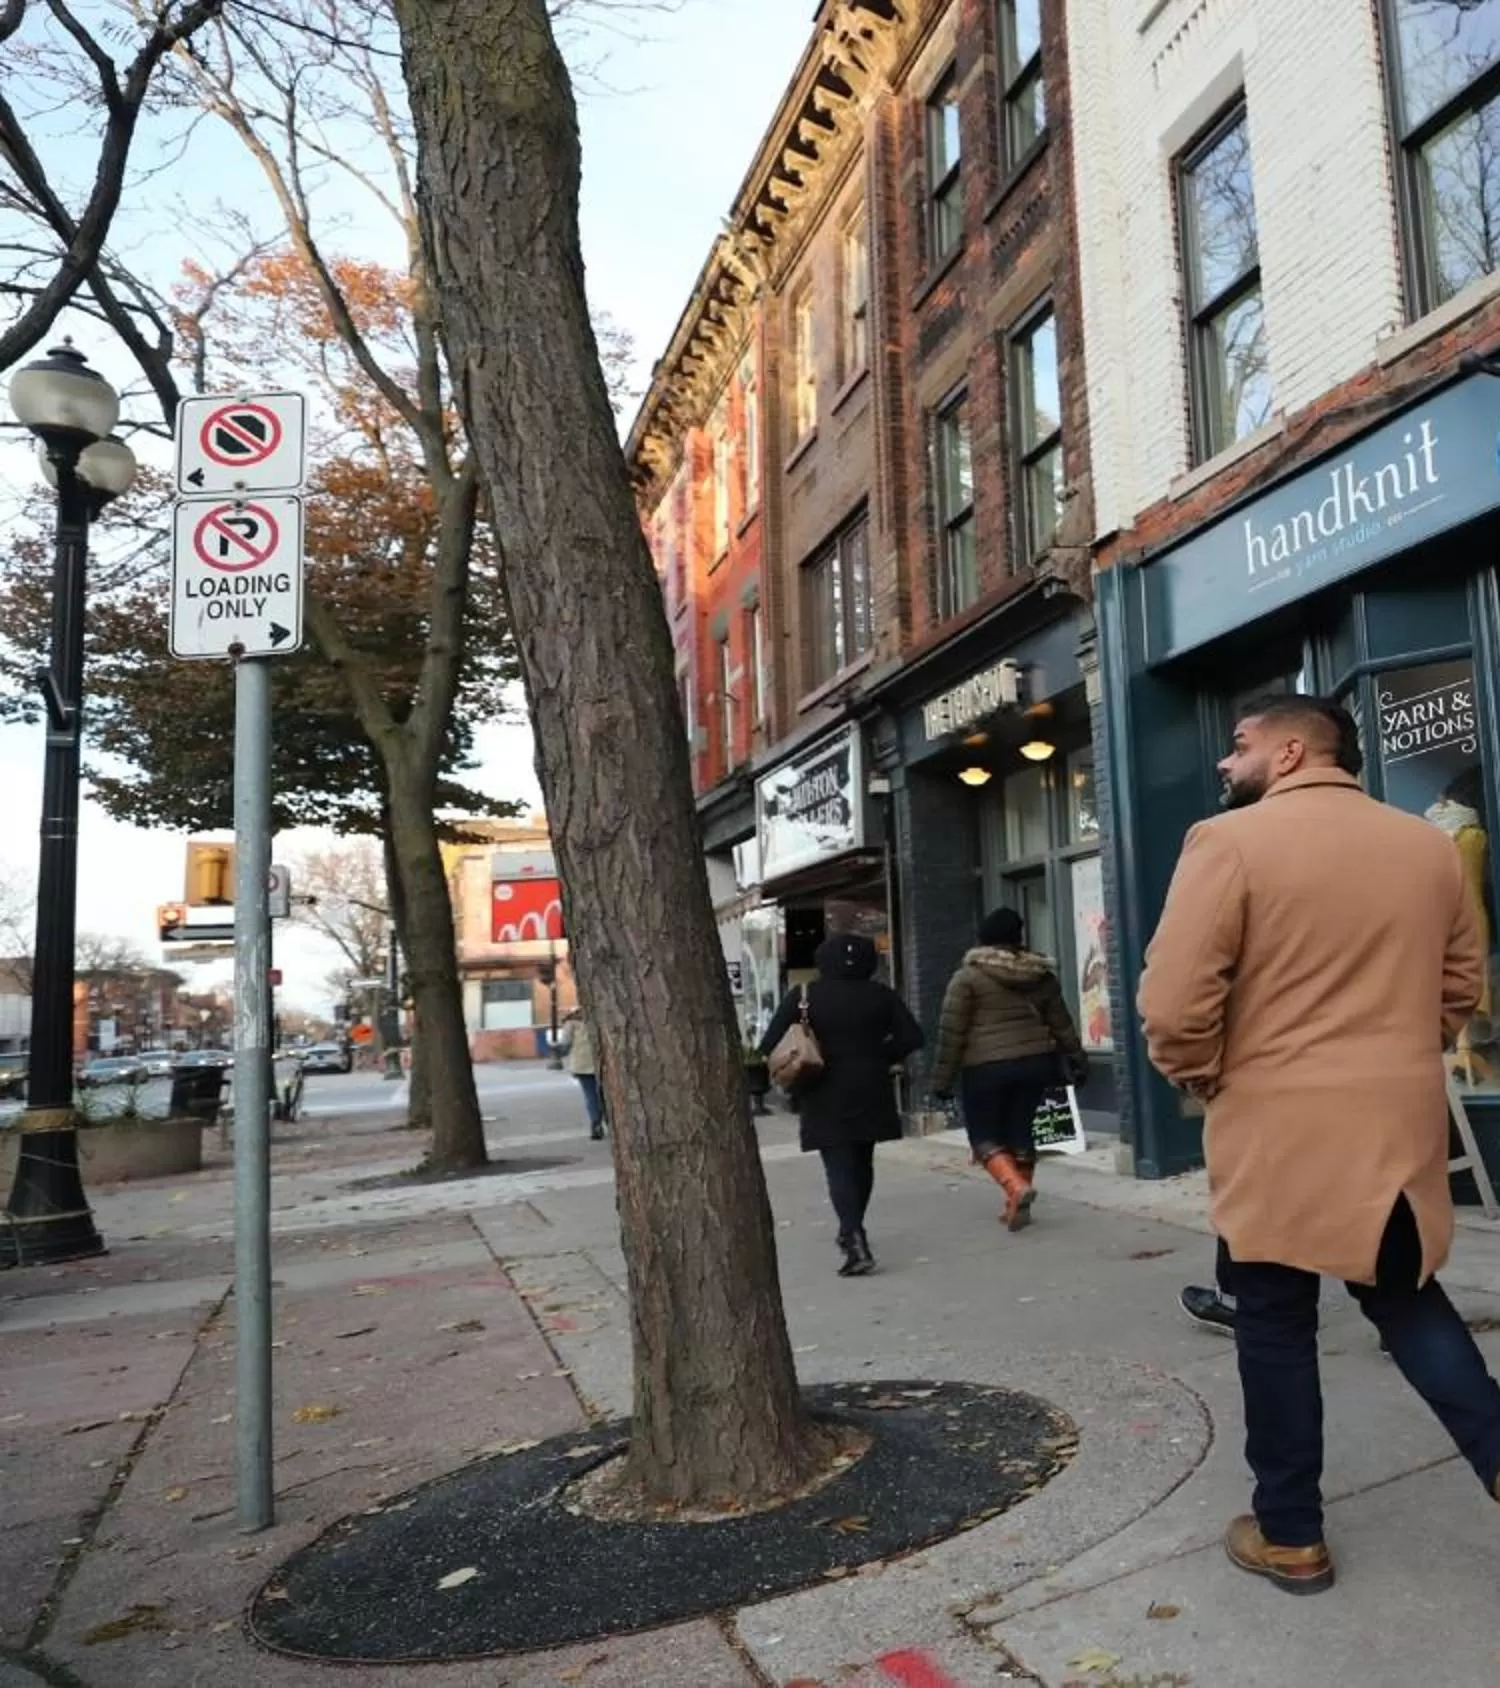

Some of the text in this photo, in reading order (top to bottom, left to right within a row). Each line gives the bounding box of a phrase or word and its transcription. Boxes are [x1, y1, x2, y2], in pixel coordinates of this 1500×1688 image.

[1244, 419, 1440, 576] handknit
[185, 572, 291, 598] LOADING
[206, 597, 268, 620] ONLY
[1381, 691, 1472, 734] YARN &
[1383, 711, 1475, 755] NOTIONS
